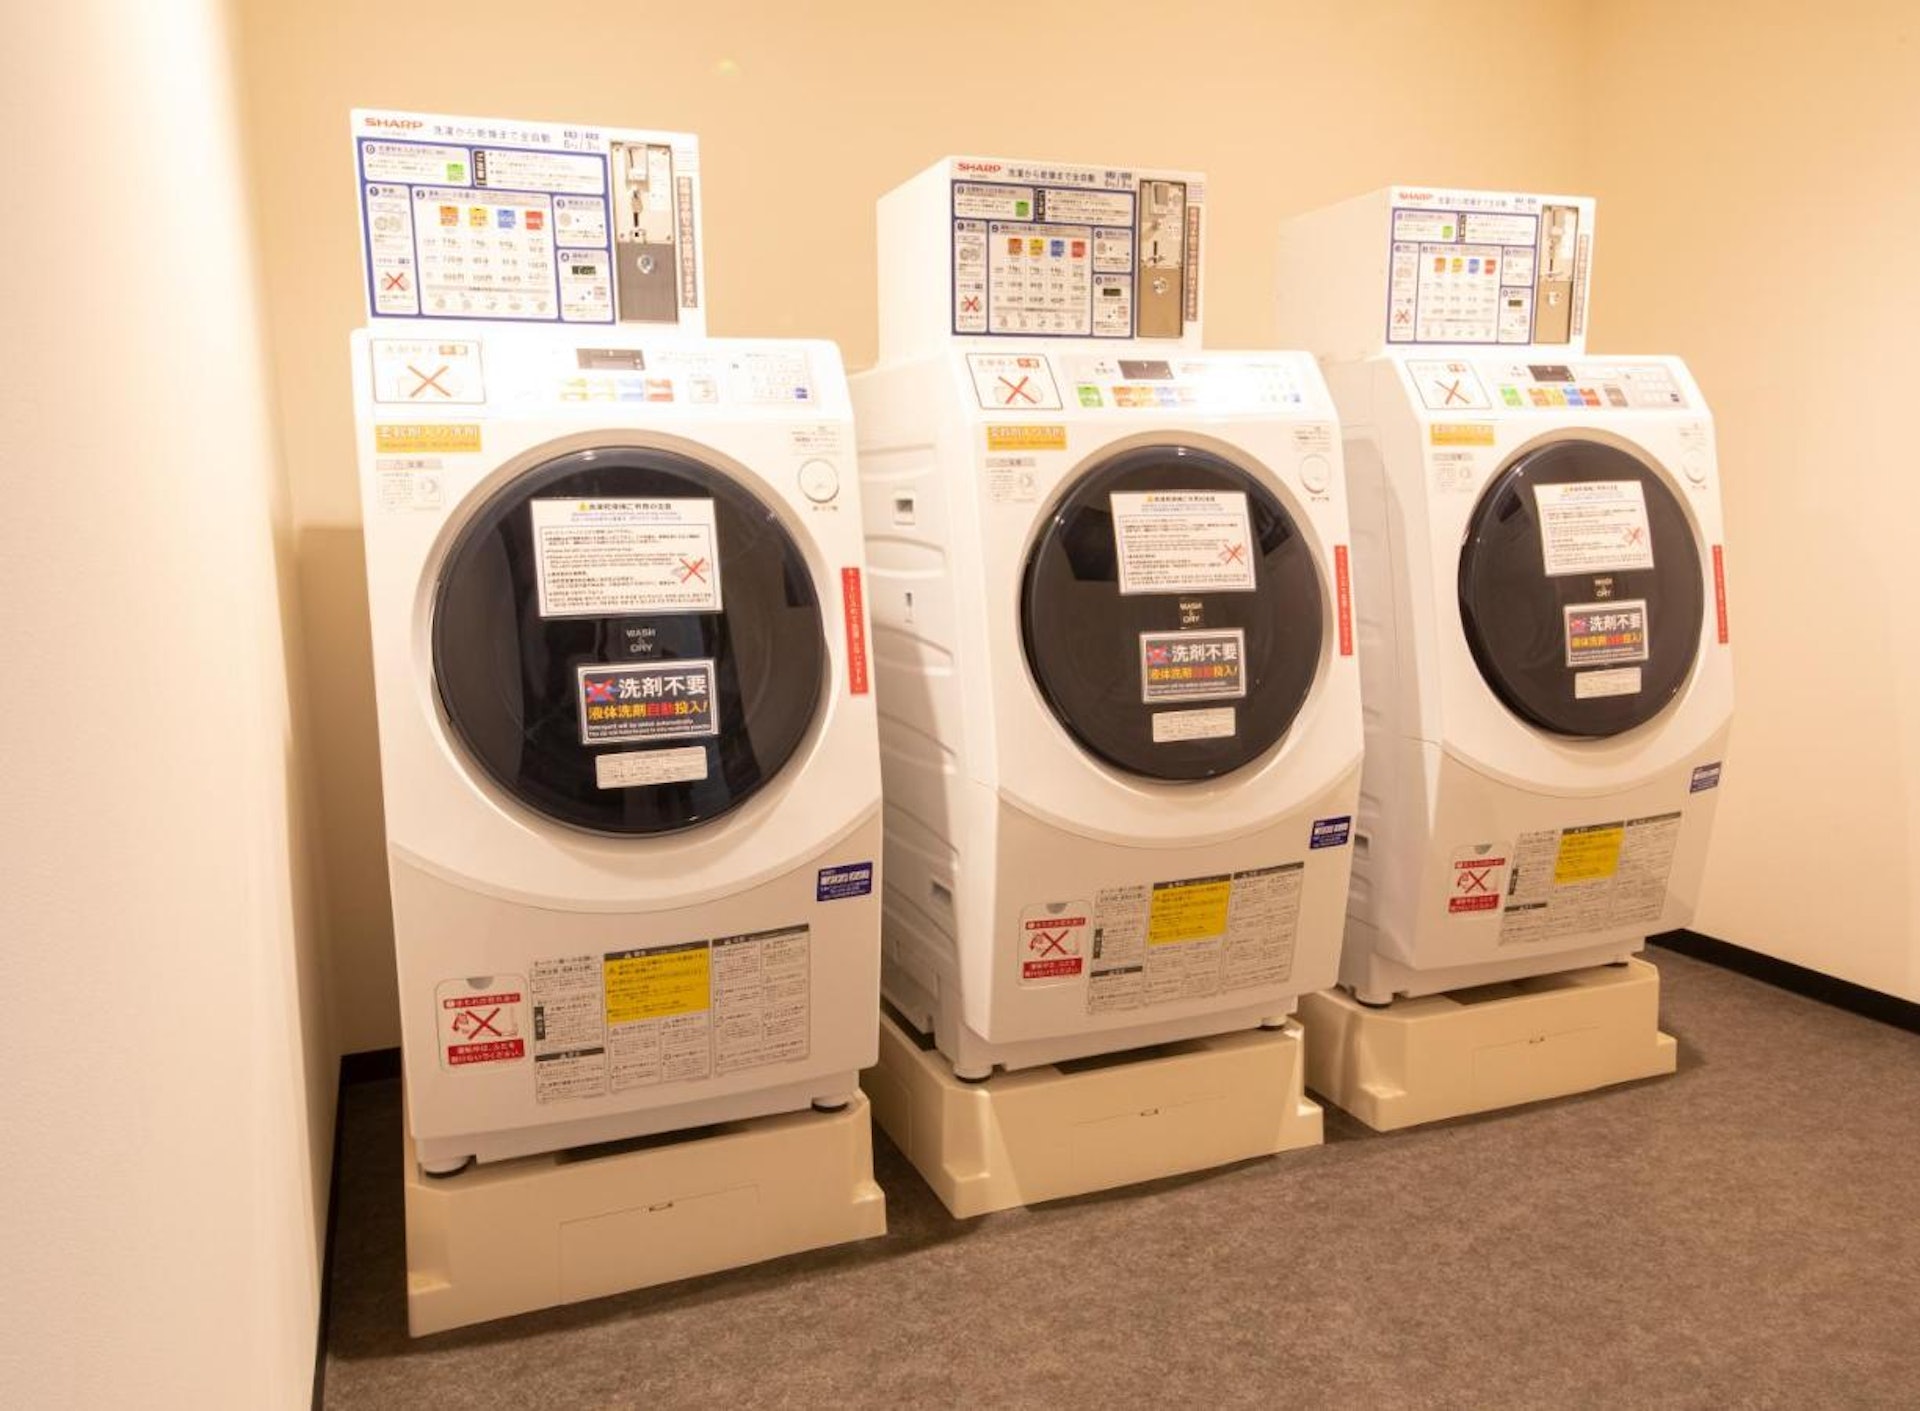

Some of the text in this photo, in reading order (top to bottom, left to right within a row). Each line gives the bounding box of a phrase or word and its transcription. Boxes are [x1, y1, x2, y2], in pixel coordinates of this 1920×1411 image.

[364, 117, 424, 130] SHARP
[958, 162, 1001, 173] SHARP
[1180, 602, 1203, 610] WASH
[1182, 615, 1200, 624] DRY
[1589, 614, 1642, 632] 洗剤不要
[626, 628, 656, 638] WASH
[630, 643, 653, 652] DRY
[1171, 642, 1238, 663] 洗剤不要
[619, 674, 707, 699] 洗剤不要
